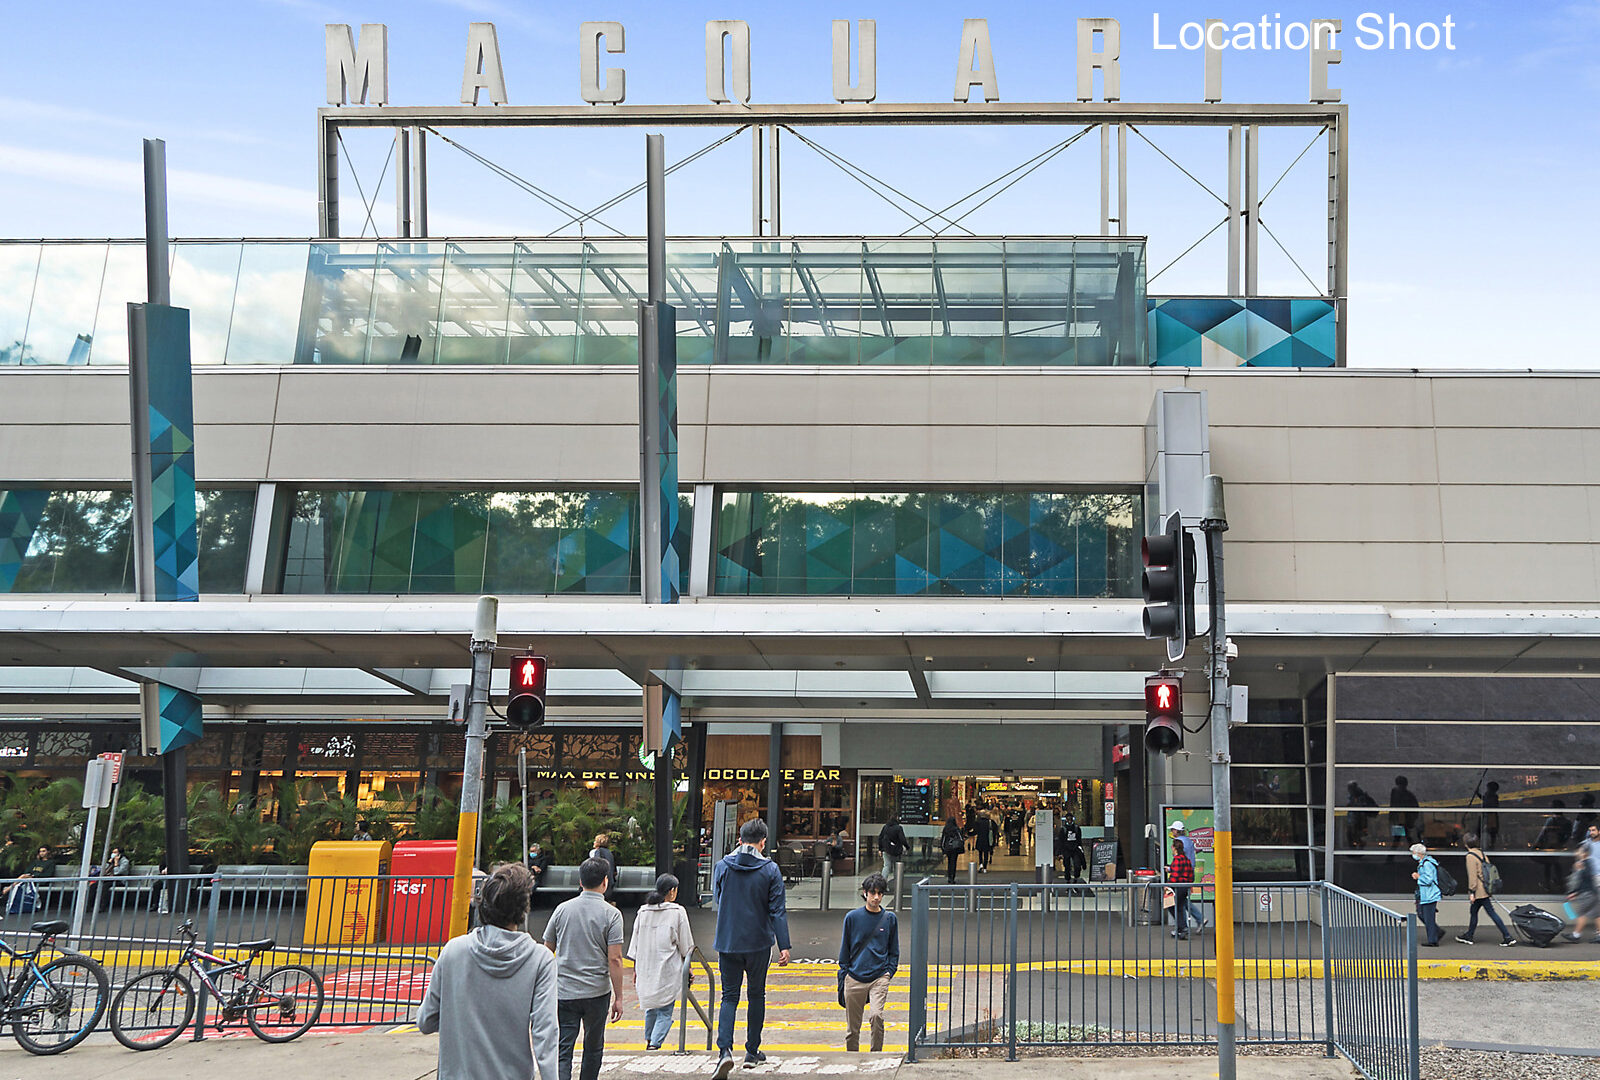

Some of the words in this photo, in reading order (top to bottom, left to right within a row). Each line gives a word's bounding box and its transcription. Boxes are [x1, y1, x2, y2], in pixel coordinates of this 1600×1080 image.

[325, 19, 1341, 107] MACQUARIE
[803, 769, 840, 780] BAR
[393, 884, 427, 895] POST
